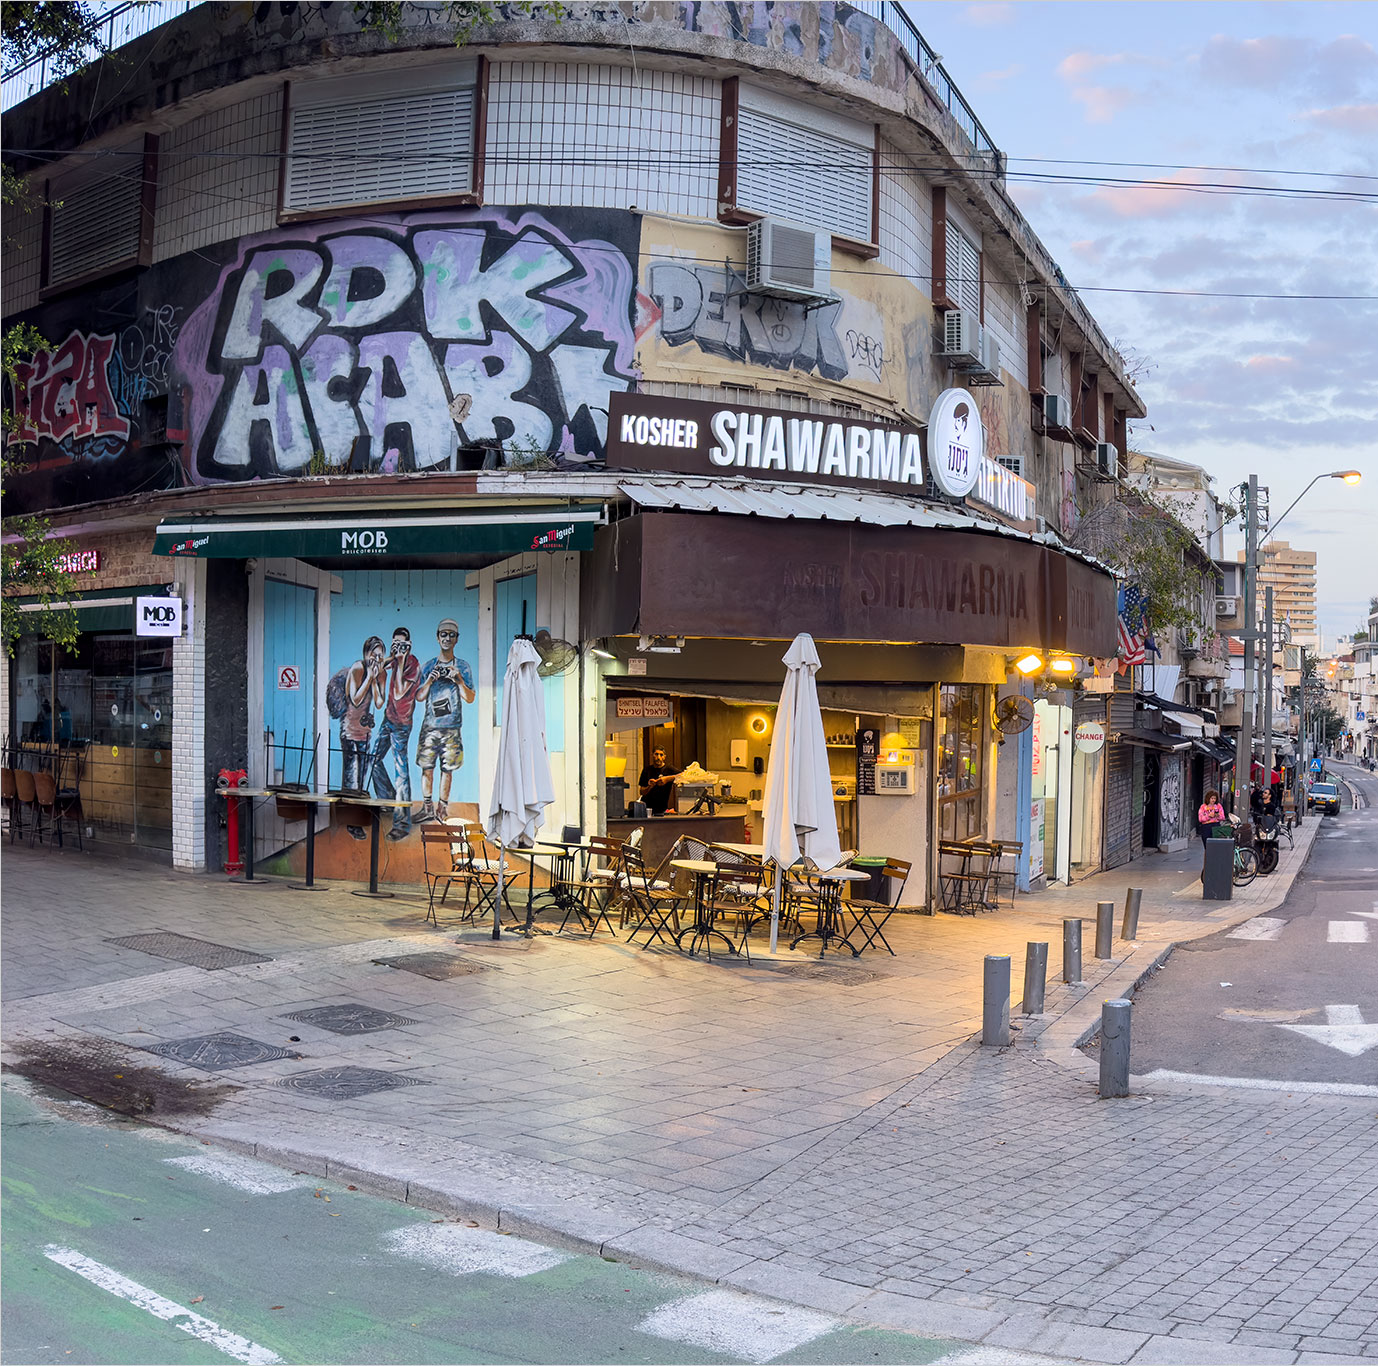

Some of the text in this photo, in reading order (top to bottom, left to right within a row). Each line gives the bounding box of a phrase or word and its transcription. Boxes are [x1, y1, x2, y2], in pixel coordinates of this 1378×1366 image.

[620, 410, 924, 485] KOSHER SHAWARMA
[341, 531, 388, 548] MOB
[547, 525, 574, 542] Miguel
[860, 552, 1029, 619] SHAWARMA
[143, 606, 176, 621] MOB
[1075, 733, 1104, 741] CHANGE
